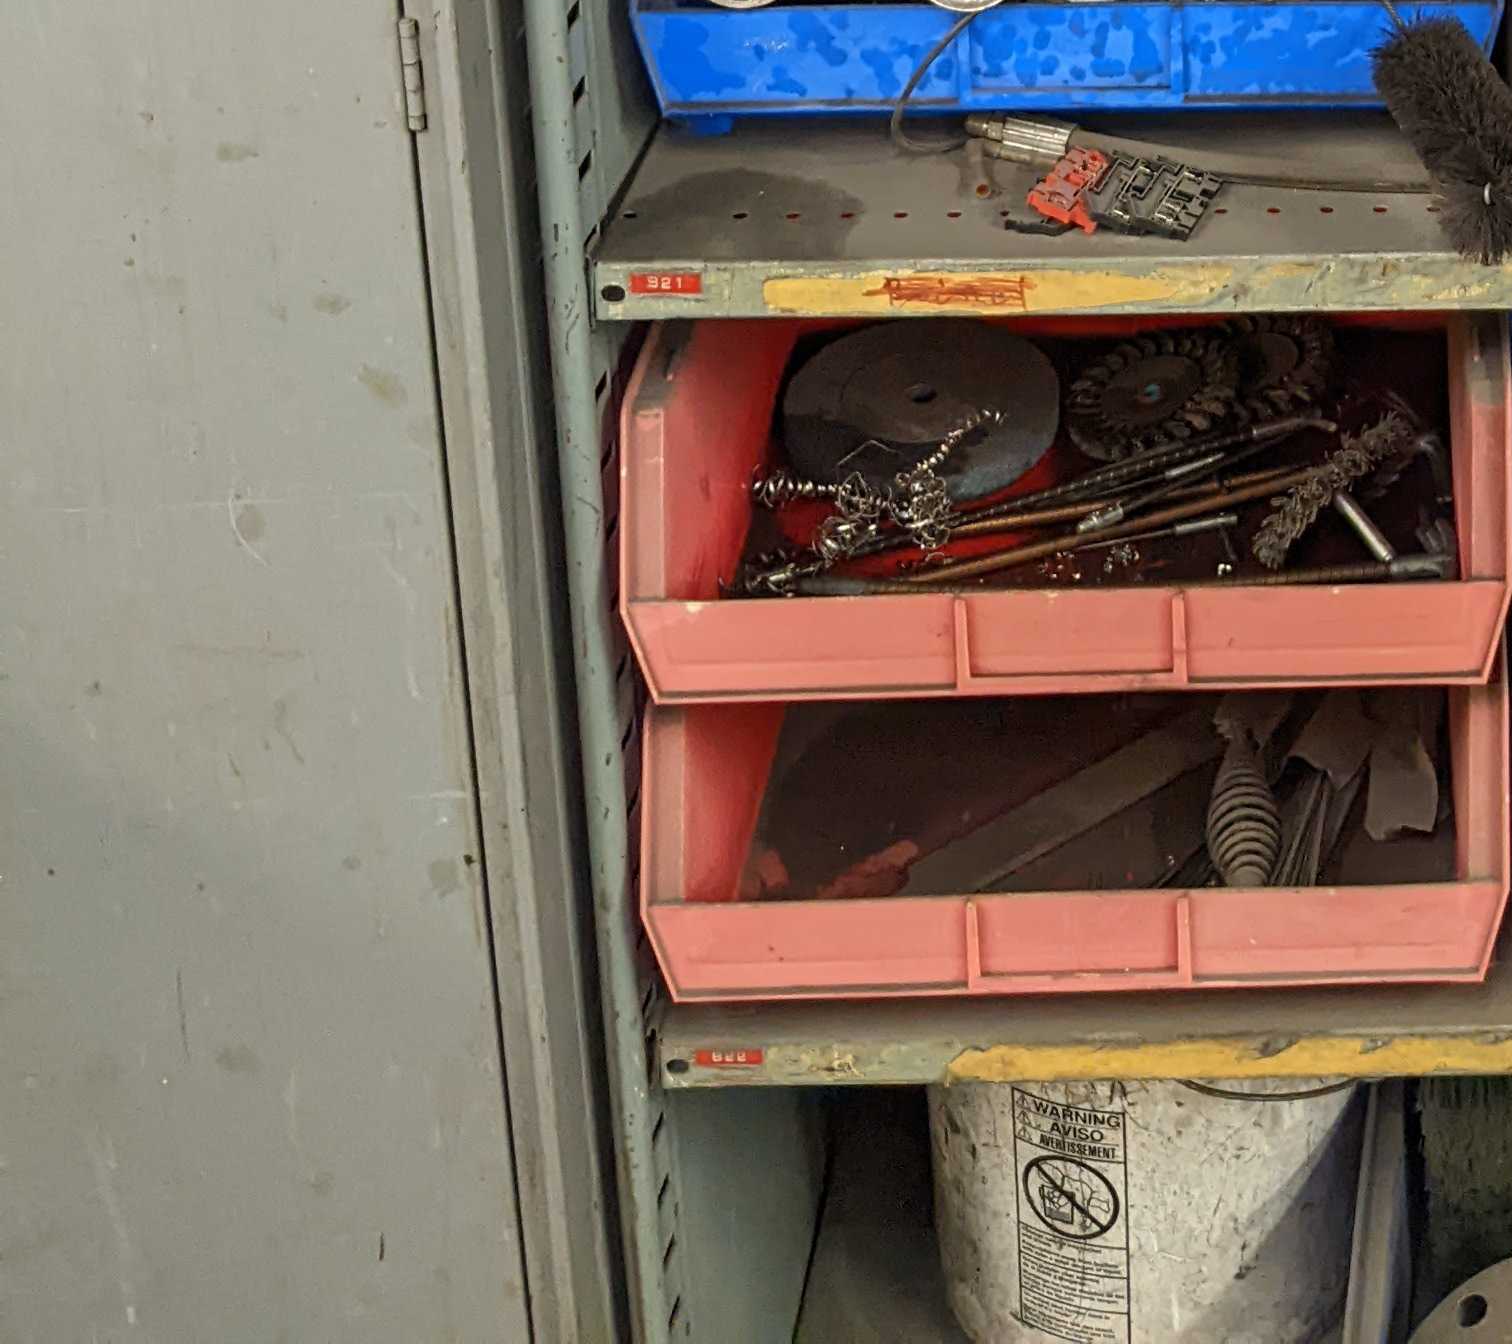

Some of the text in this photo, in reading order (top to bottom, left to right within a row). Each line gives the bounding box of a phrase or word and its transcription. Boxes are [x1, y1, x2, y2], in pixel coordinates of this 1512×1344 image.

[1032, 1098, 1121, 1129] WARNING
[1050, 1122, 1104, 1143] AVISO
[1039, 1133, 1117, 1160] AVERTISSEMENT
